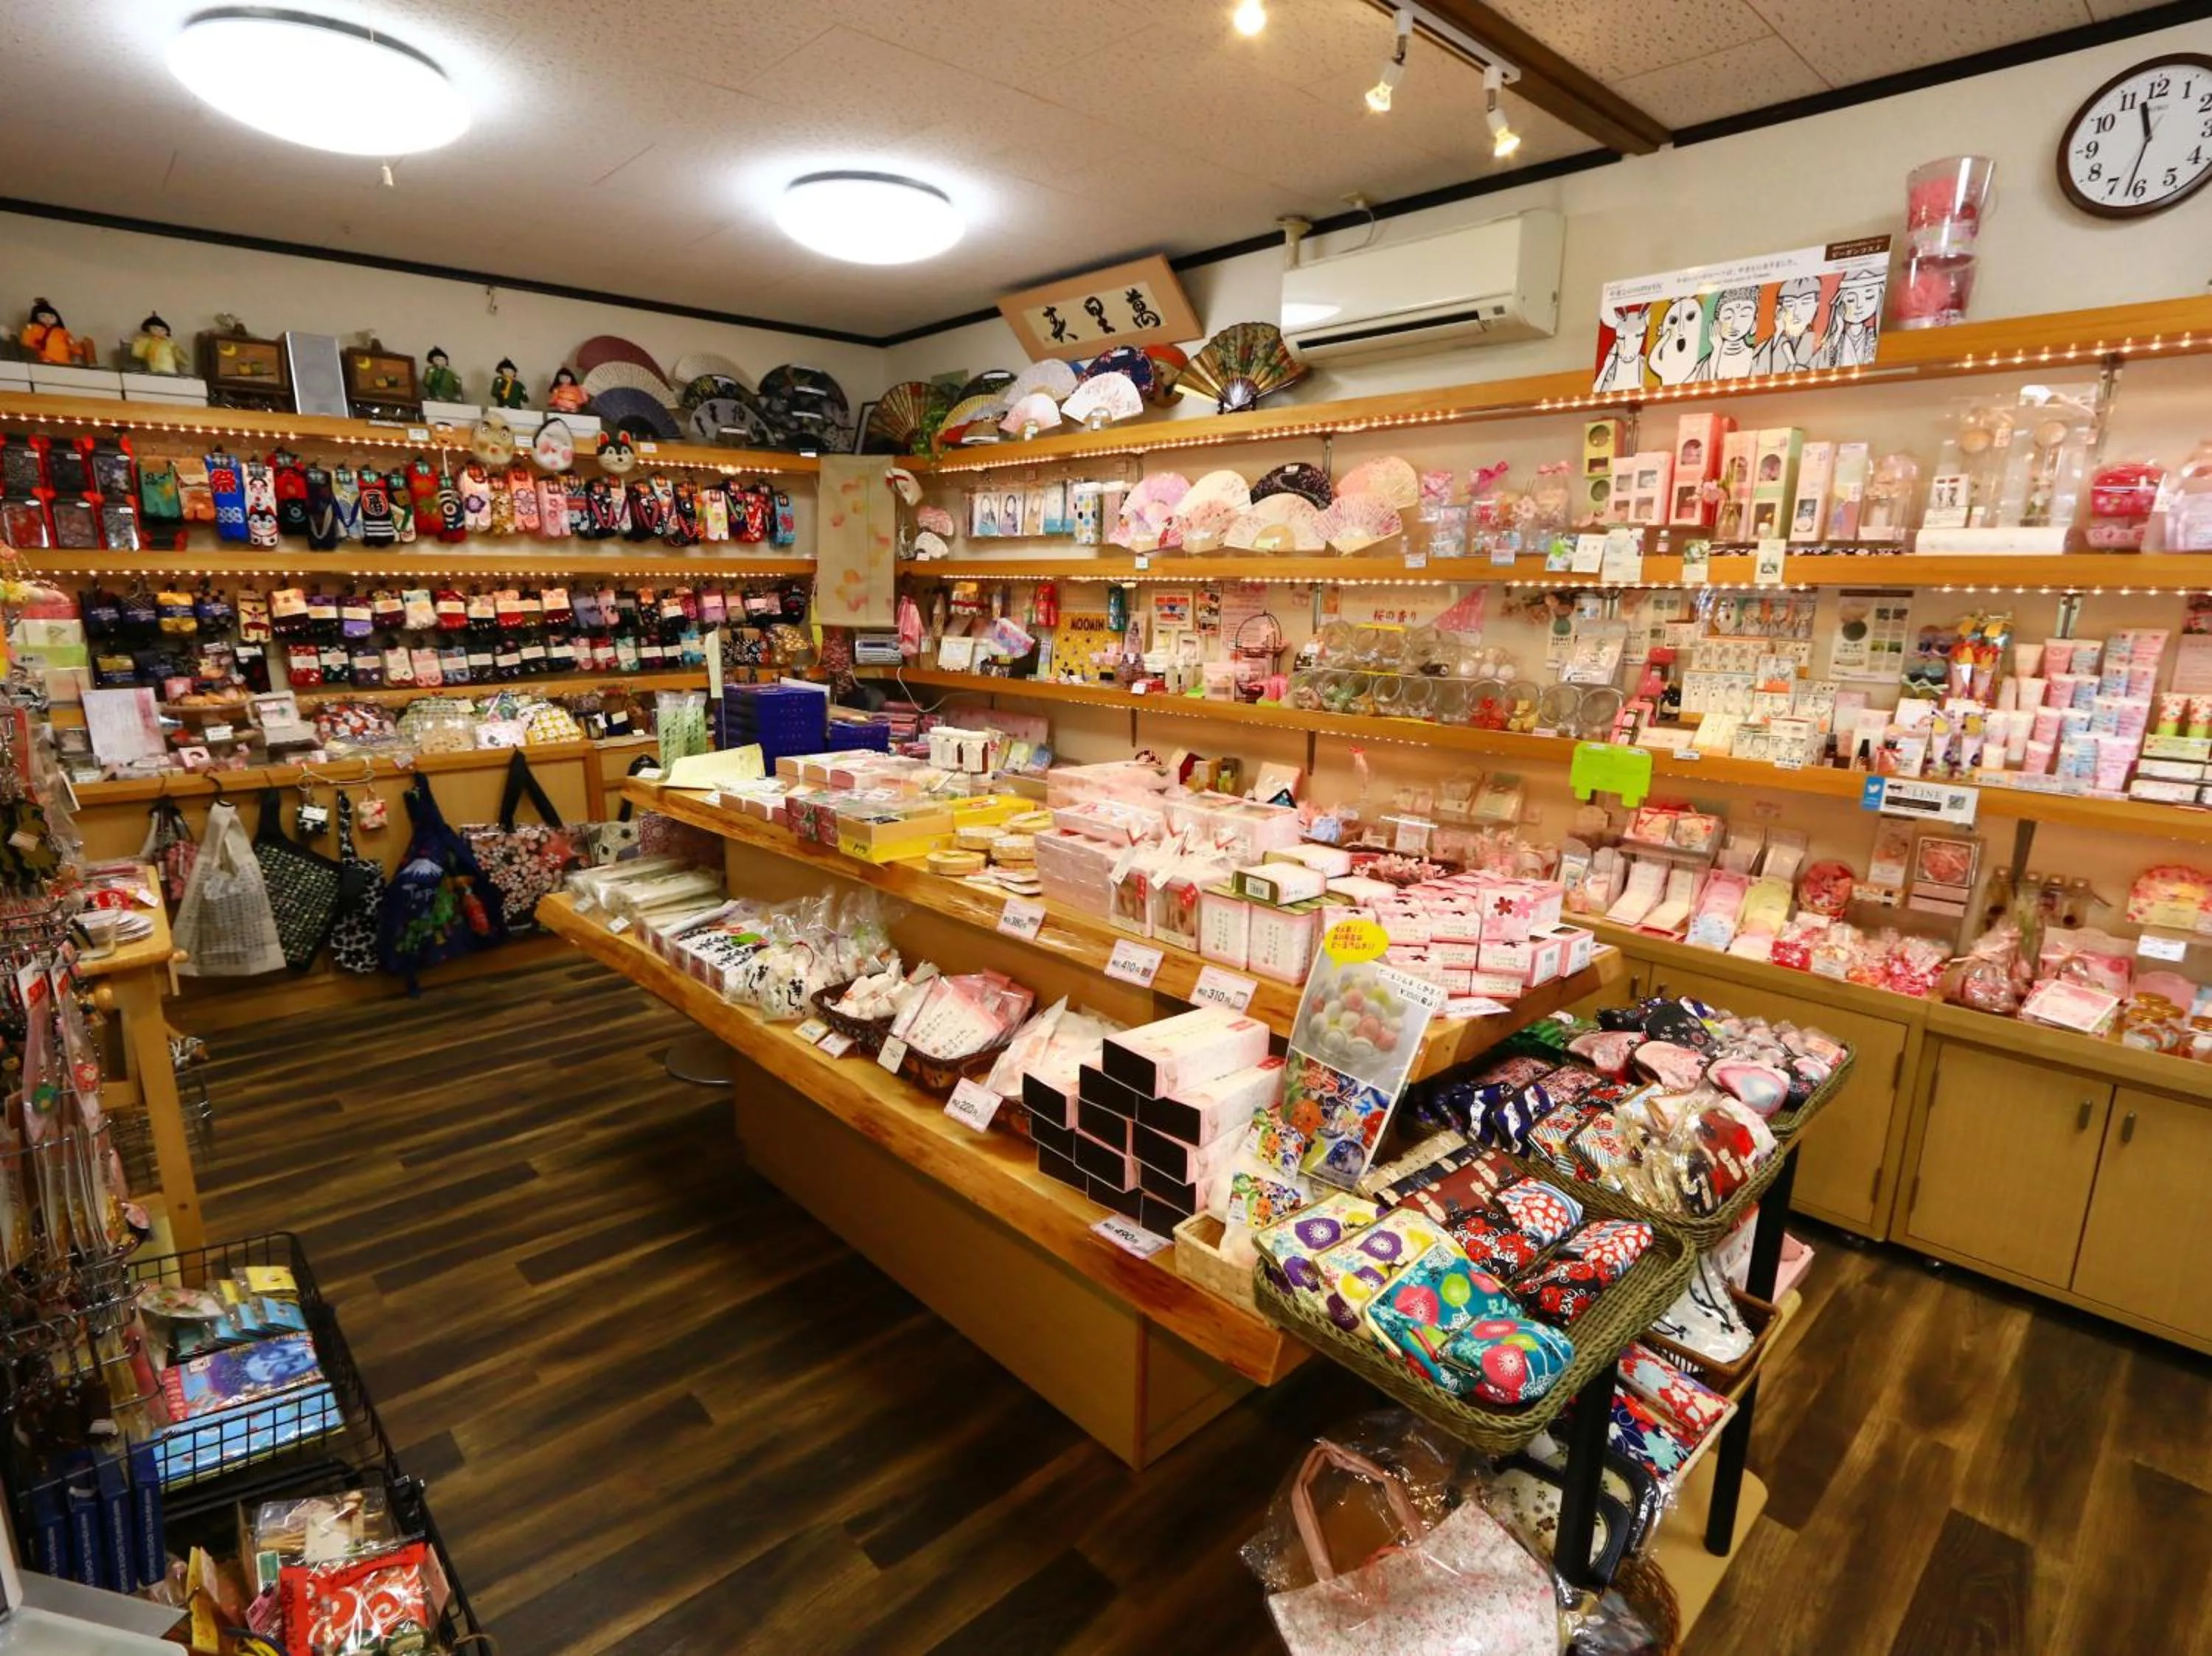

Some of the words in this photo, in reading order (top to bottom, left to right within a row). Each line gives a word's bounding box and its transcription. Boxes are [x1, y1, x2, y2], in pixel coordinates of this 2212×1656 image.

[2149, 78, 2170, 100] 12
[2182, 80, 2191, 99] 1
[2120, 92, 2136, 111] 11
[2198, 93, 2212, 113] 2
[2094, 114, 2115, 134] 10
[2085, 141, 2098, 159] 9
[2185, 145, 2202, 164] 4
[2087, 163, 2101, 181] 8
[2163, 167, 2177, 186] 5
[2107, 177, 2120, 195] 7
[2132, 179, 2146, 197] 6
[212, 468, 236, 493] 祭
